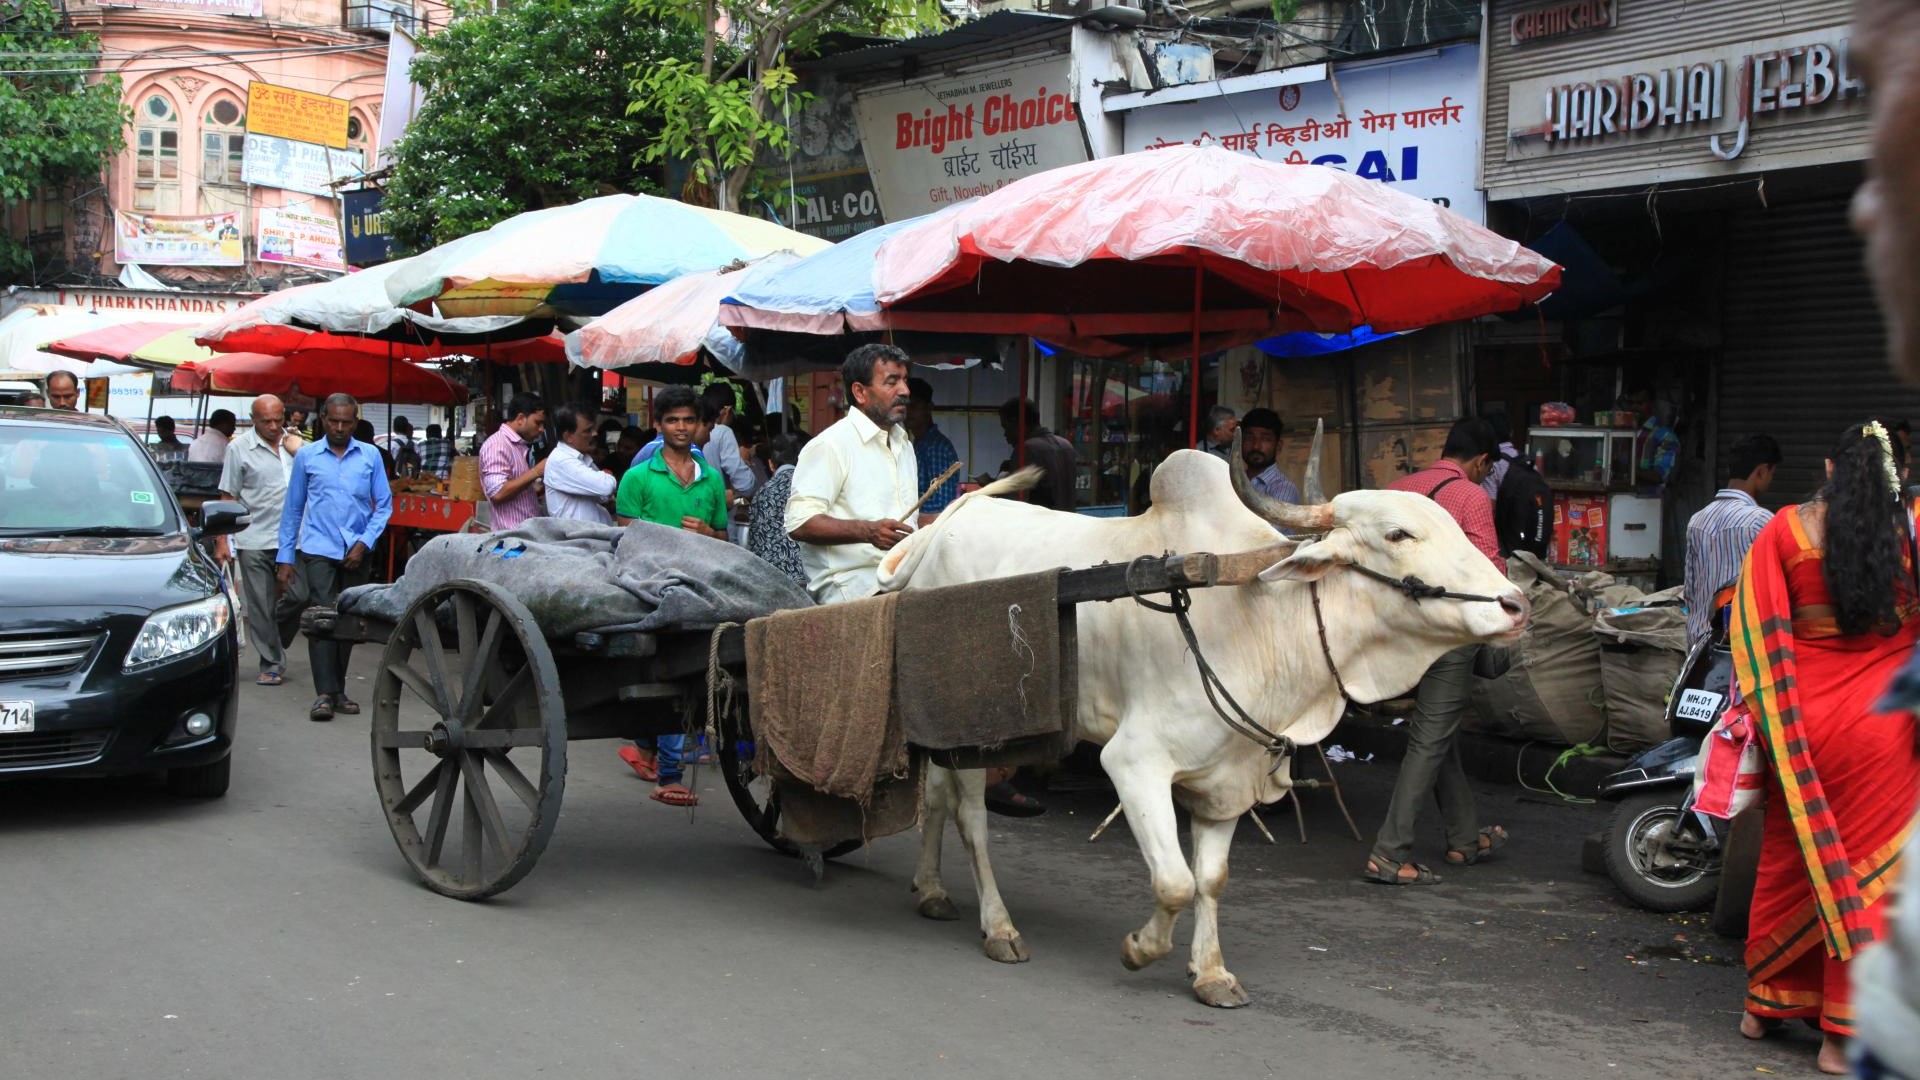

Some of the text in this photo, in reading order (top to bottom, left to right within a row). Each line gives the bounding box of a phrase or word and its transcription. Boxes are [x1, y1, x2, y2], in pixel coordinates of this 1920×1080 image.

[1513, 0, 1608, 40] CHEMICALS
[979, 79, 1013, 92] JEWELLERS
[1511, 58, 1725, 142] HARIBHAI
[896, 102, 974, 155] Bright
[982, 86, 1078, 136] Choice
[1219, 122, 1262, 153] साई
[1360, 109, 1397, 134] गेम
[1402, 96, 1464, 129] पार्लर
[843, 190, 878, 218] CO.
[929, 186, 952, 204] Gift,
[364, 213, 391, 236] UR
[92, 294, 226, 314] HARKISHANDAS
[1686, 694, 1712, 706] MH.01
[1, 708, 29, 725] 714
[1678, 706, 1711, 720] AJ.8419
